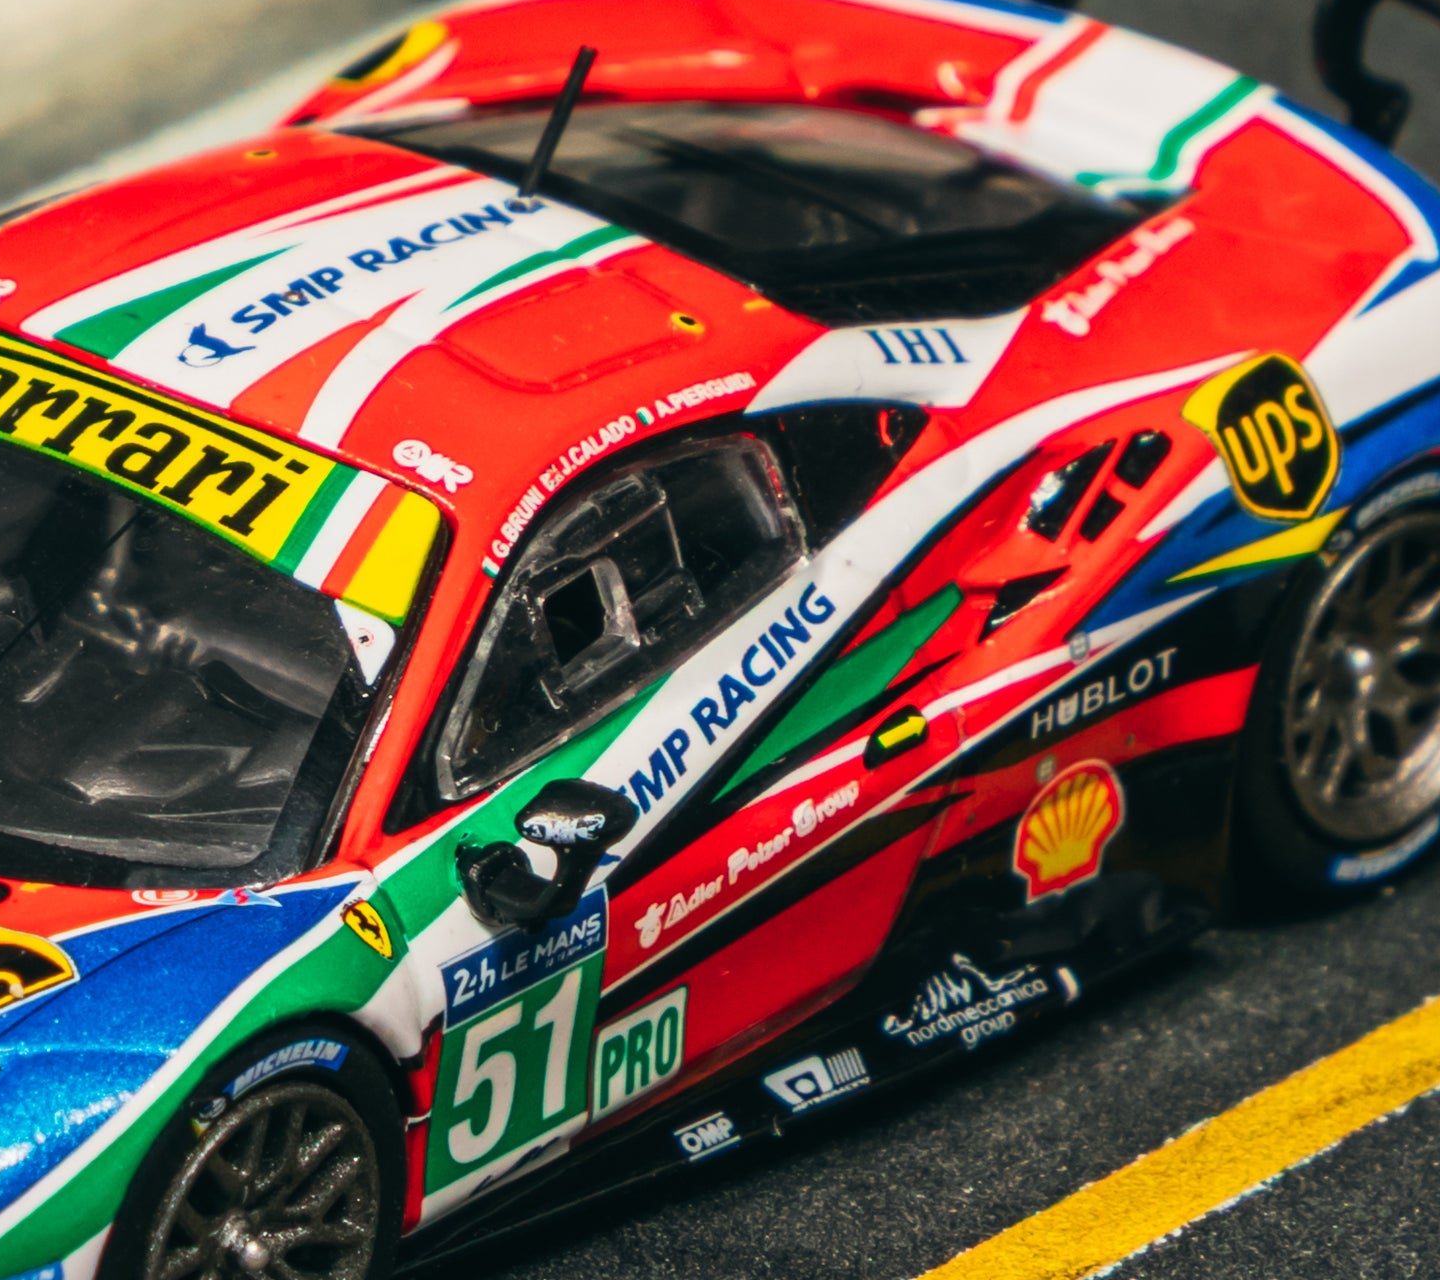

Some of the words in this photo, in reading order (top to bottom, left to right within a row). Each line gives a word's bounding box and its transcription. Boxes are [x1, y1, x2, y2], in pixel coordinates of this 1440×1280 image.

[231, 267, 344, 334] SMP
[864, 328, 970, 363] IHI
[616, 728, 690, 816] MP
[690, 582, 836, 745] RACING
[1031, 648, 1178, 738] HUBLOT
[501, 950, 530, 981] LE
[534, 913, 601, 963] MANS
[232, 1040, 342, 1096] MICHELIN
[447, 966, 583, 1164] 51
[600, 1006, 678, 1109] PRO
[680, 1117, 735, 1153] OMP
